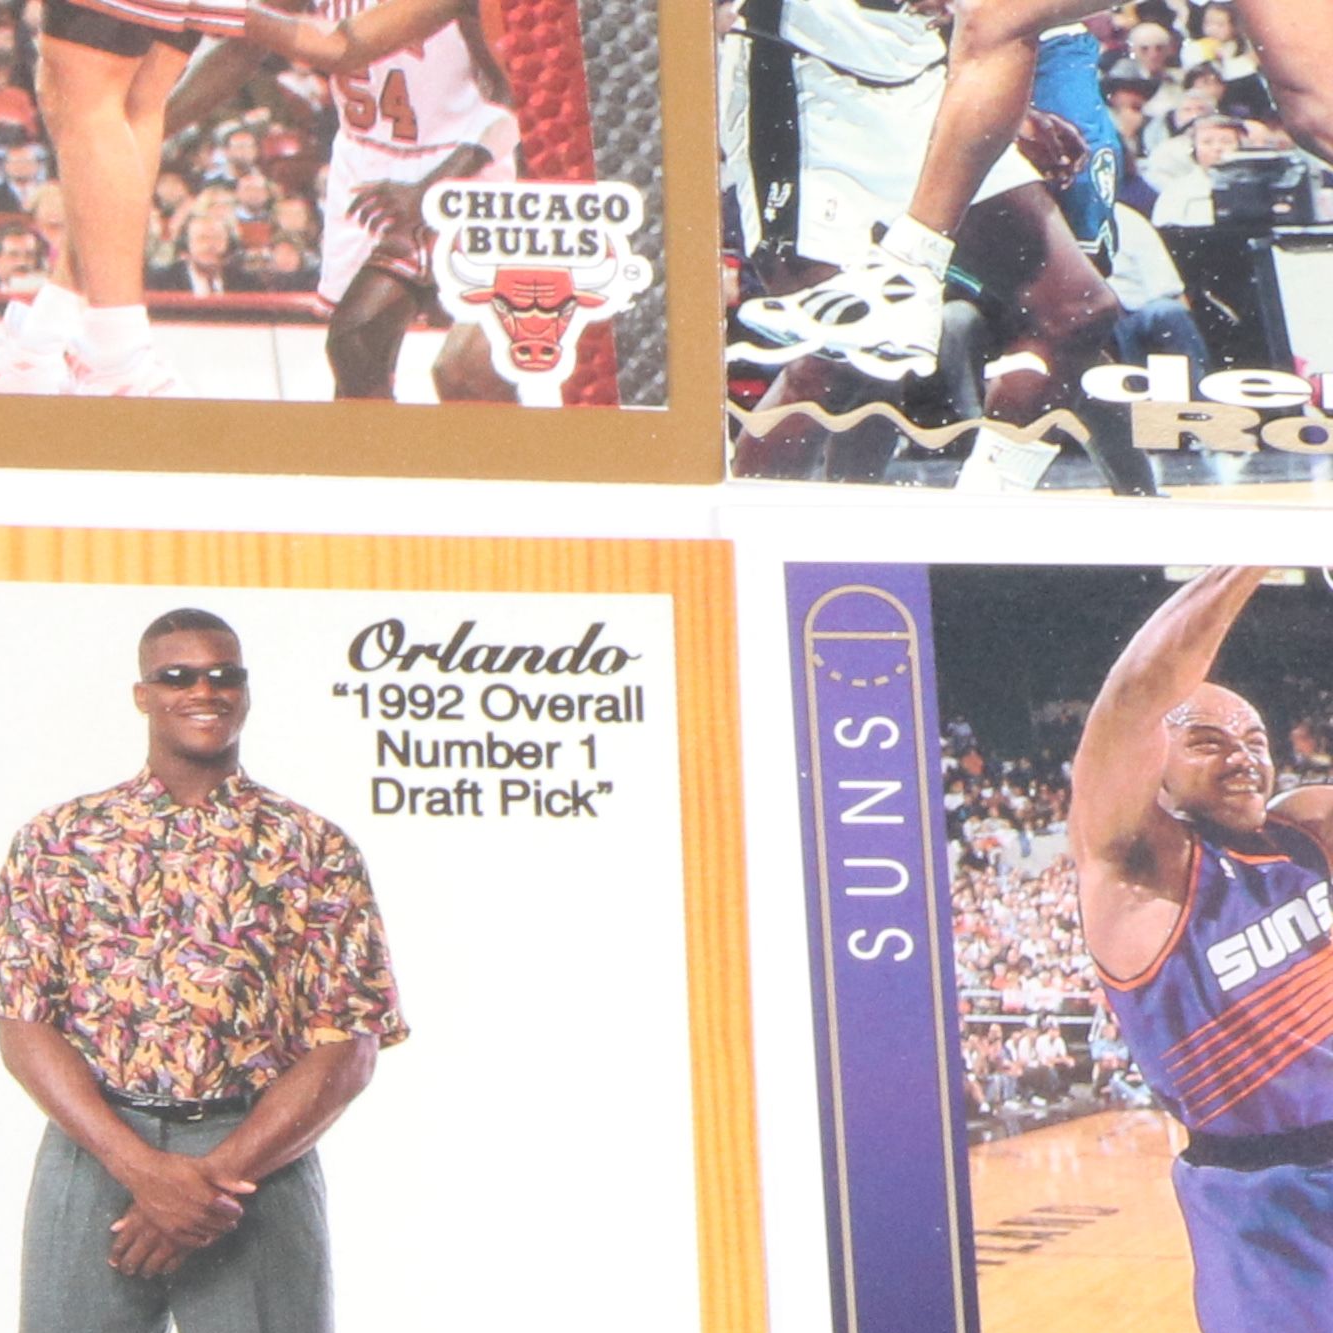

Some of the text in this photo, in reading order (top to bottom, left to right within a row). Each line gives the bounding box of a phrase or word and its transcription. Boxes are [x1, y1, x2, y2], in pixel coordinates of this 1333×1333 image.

[438, 189, 631, 223] CHICAGO
[466, 225, 601, 258] BULLS
[347, 617, 643, 676] Orlando
[480, 682, 645, 723] Overall
[376, 729, 597, 770] Number 1
[370, 776, 484, 818] Draft
[833, 715, 915, 962] SUNS
